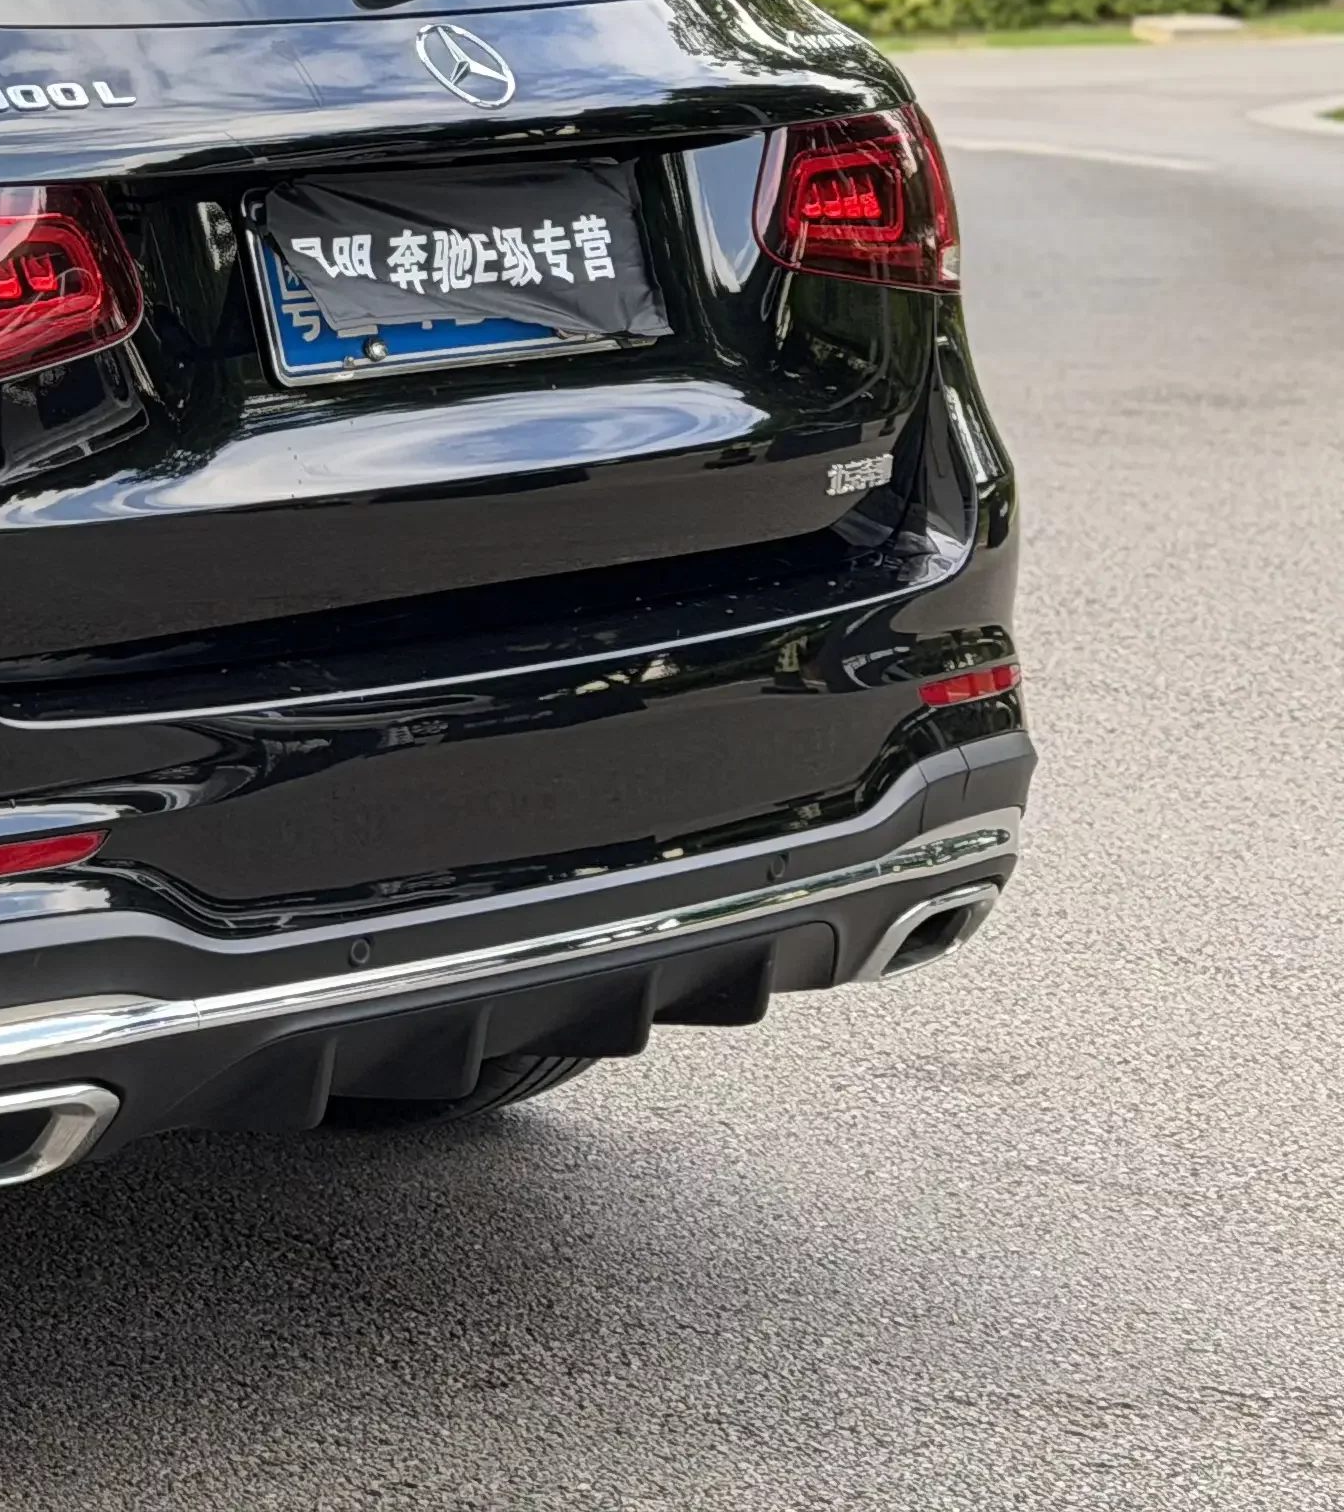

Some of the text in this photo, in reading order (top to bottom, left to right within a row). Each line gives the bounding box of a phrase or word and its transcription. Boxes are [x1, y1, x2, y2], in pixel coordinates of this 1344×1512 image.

[93, 81, 136, 108] L
[387, 215, 616, 295] 奔驰E级专营
